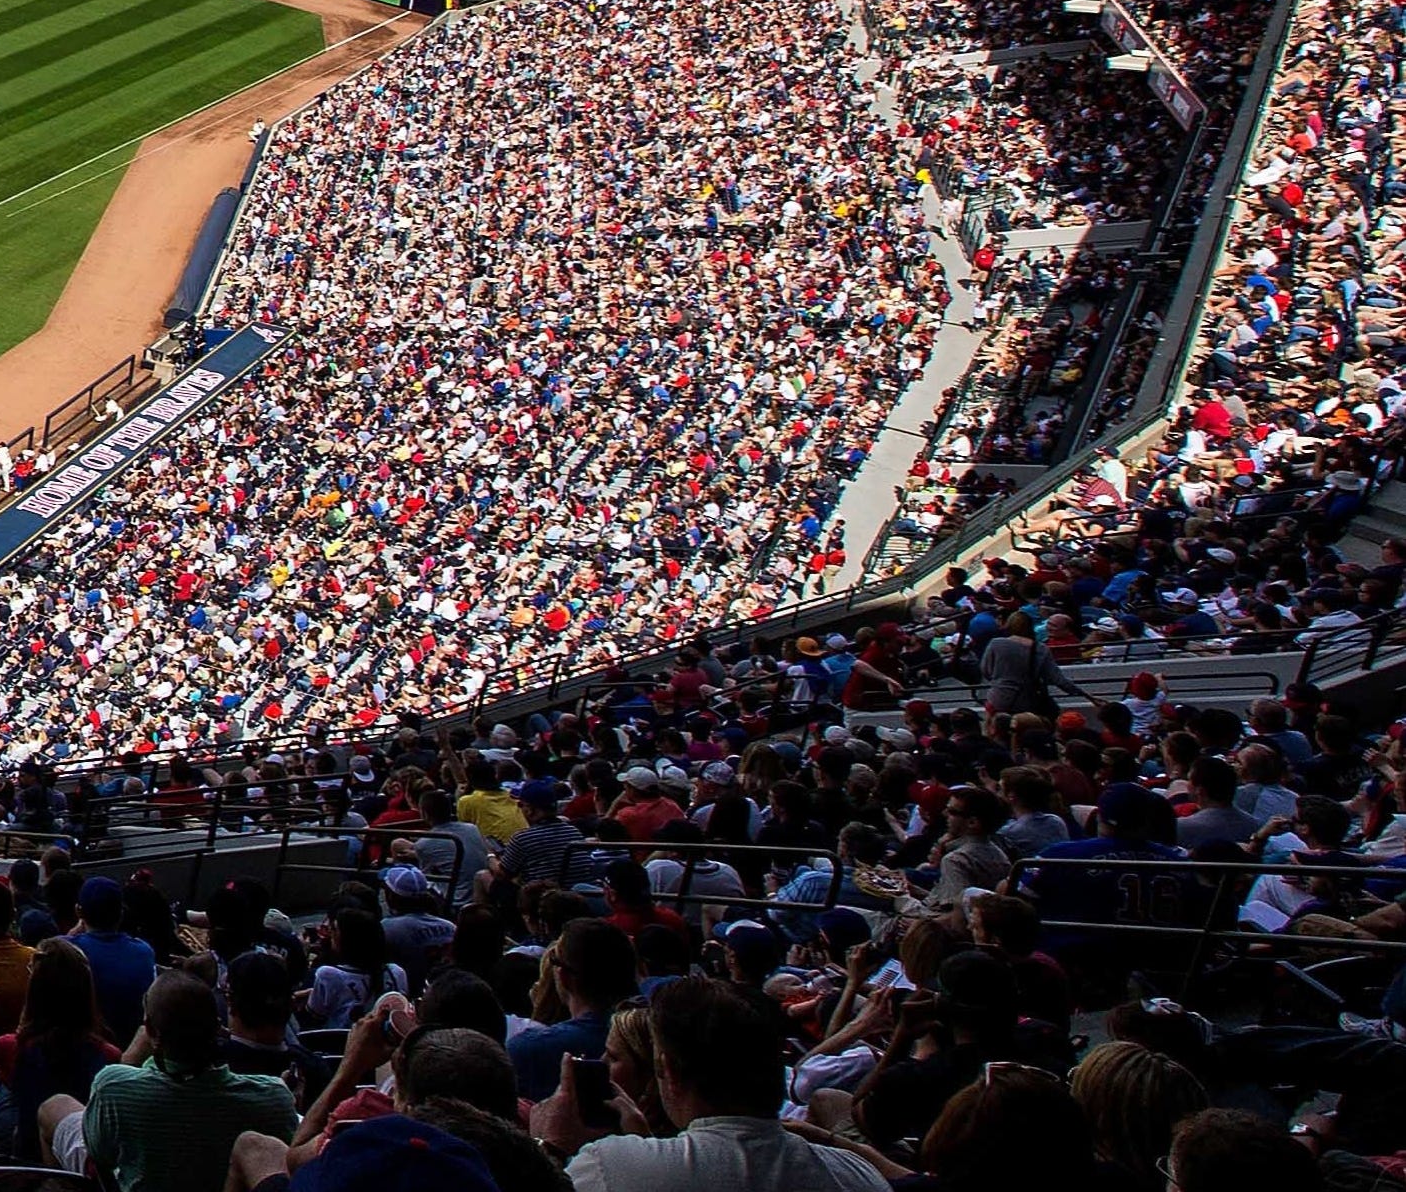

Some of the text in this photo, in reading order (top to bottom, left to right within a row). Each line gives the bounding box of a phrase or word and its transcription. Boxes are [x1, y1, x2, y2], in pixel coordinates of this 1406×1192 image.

[17, 367, 227, 520] HOME OF THE BRAVES
